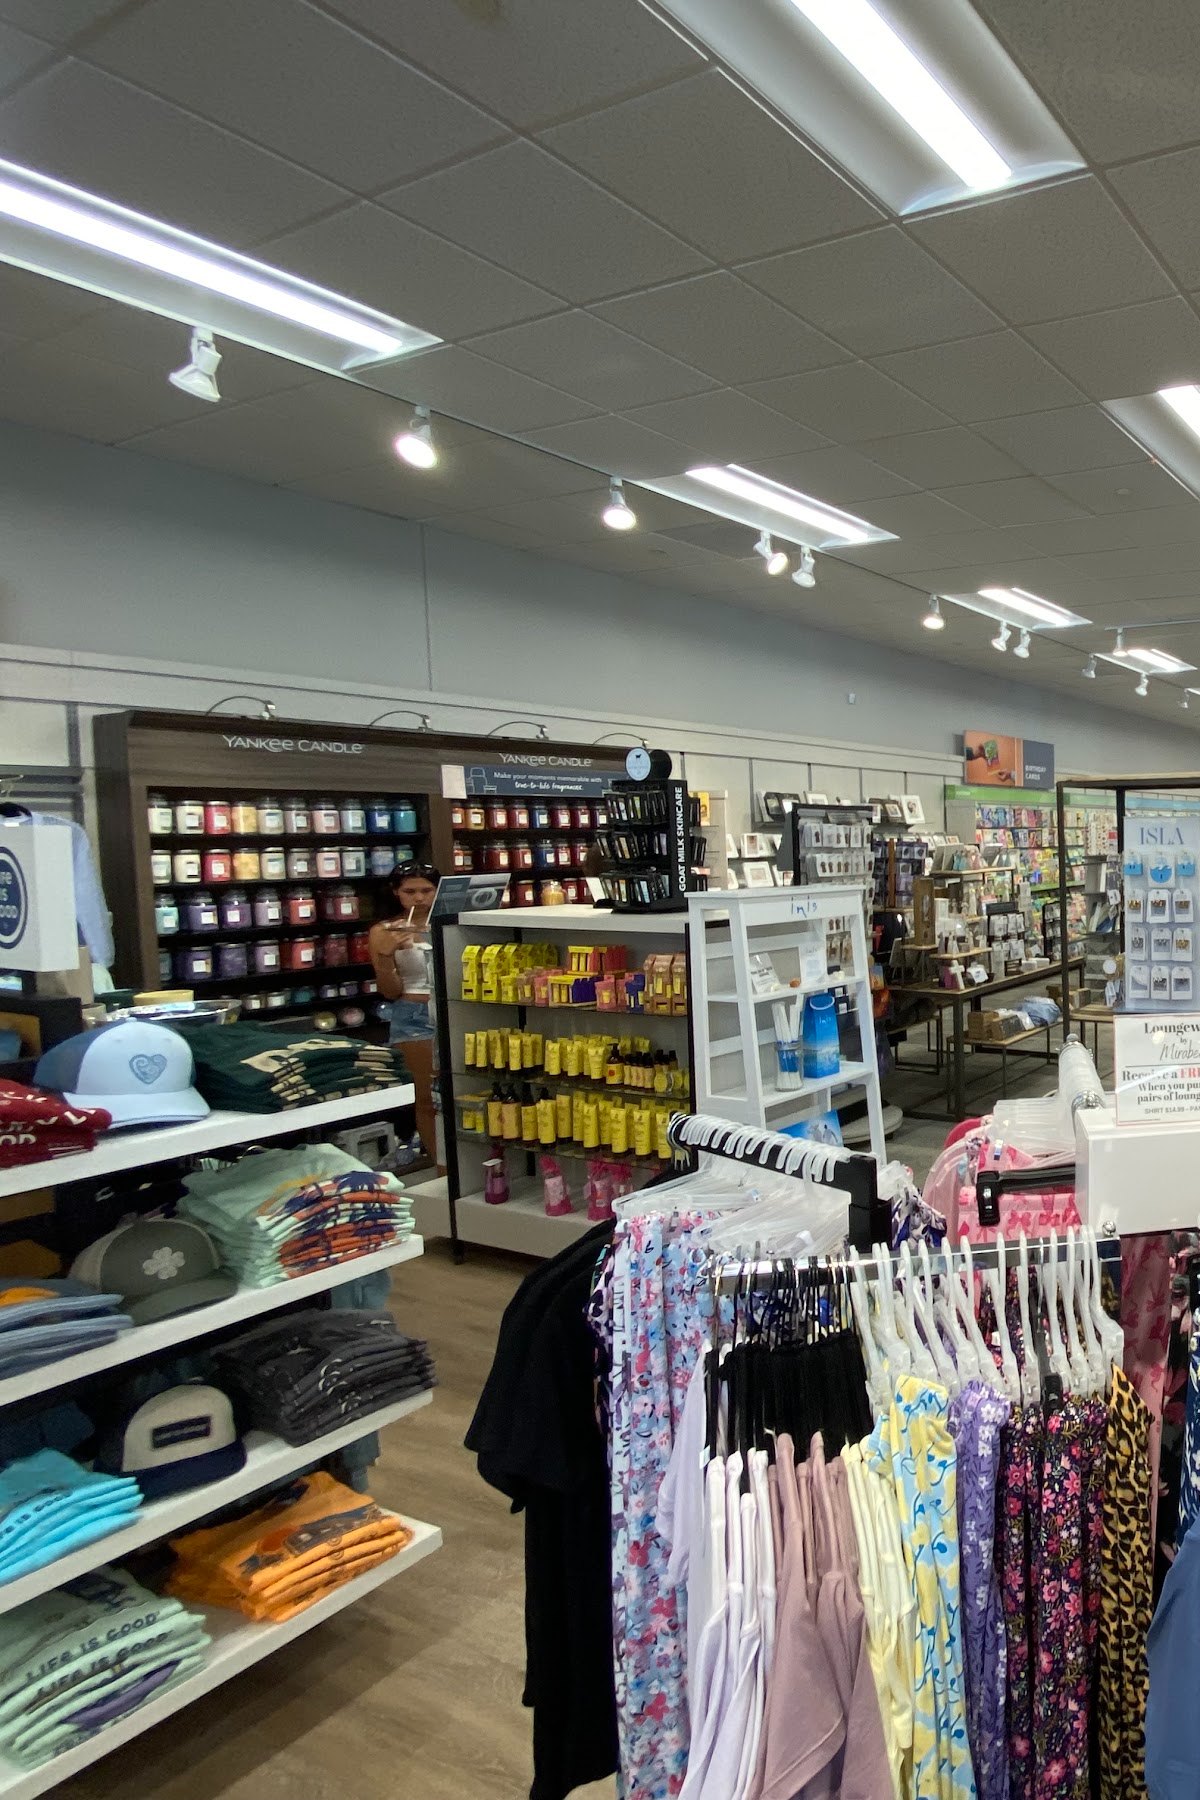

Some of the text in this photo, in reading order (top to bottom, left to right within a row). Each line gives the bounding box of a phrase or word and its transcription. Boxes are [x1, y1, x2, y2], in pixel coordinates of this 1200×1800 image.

[1025, 765, 1046, 773] BIRTHDAY
[1025, 772, 1041, 780] CARDS
[675, 786, 687, 892] GOAT MILK SKINCARE
[1140, 827, 1185, 845] ISLA
[1180, 1036, 1188, 1045] by
[1171, 1071, 1178, 1079] a
[1138, 1082, 1166, 1092] When
[1167, 1082, 1185, 1093] you
[1137, 1094, 1162, 1105] pairs
[1163, 1092, 1173, 1101] of
[106, 1612, 158, 1642] GOOD
